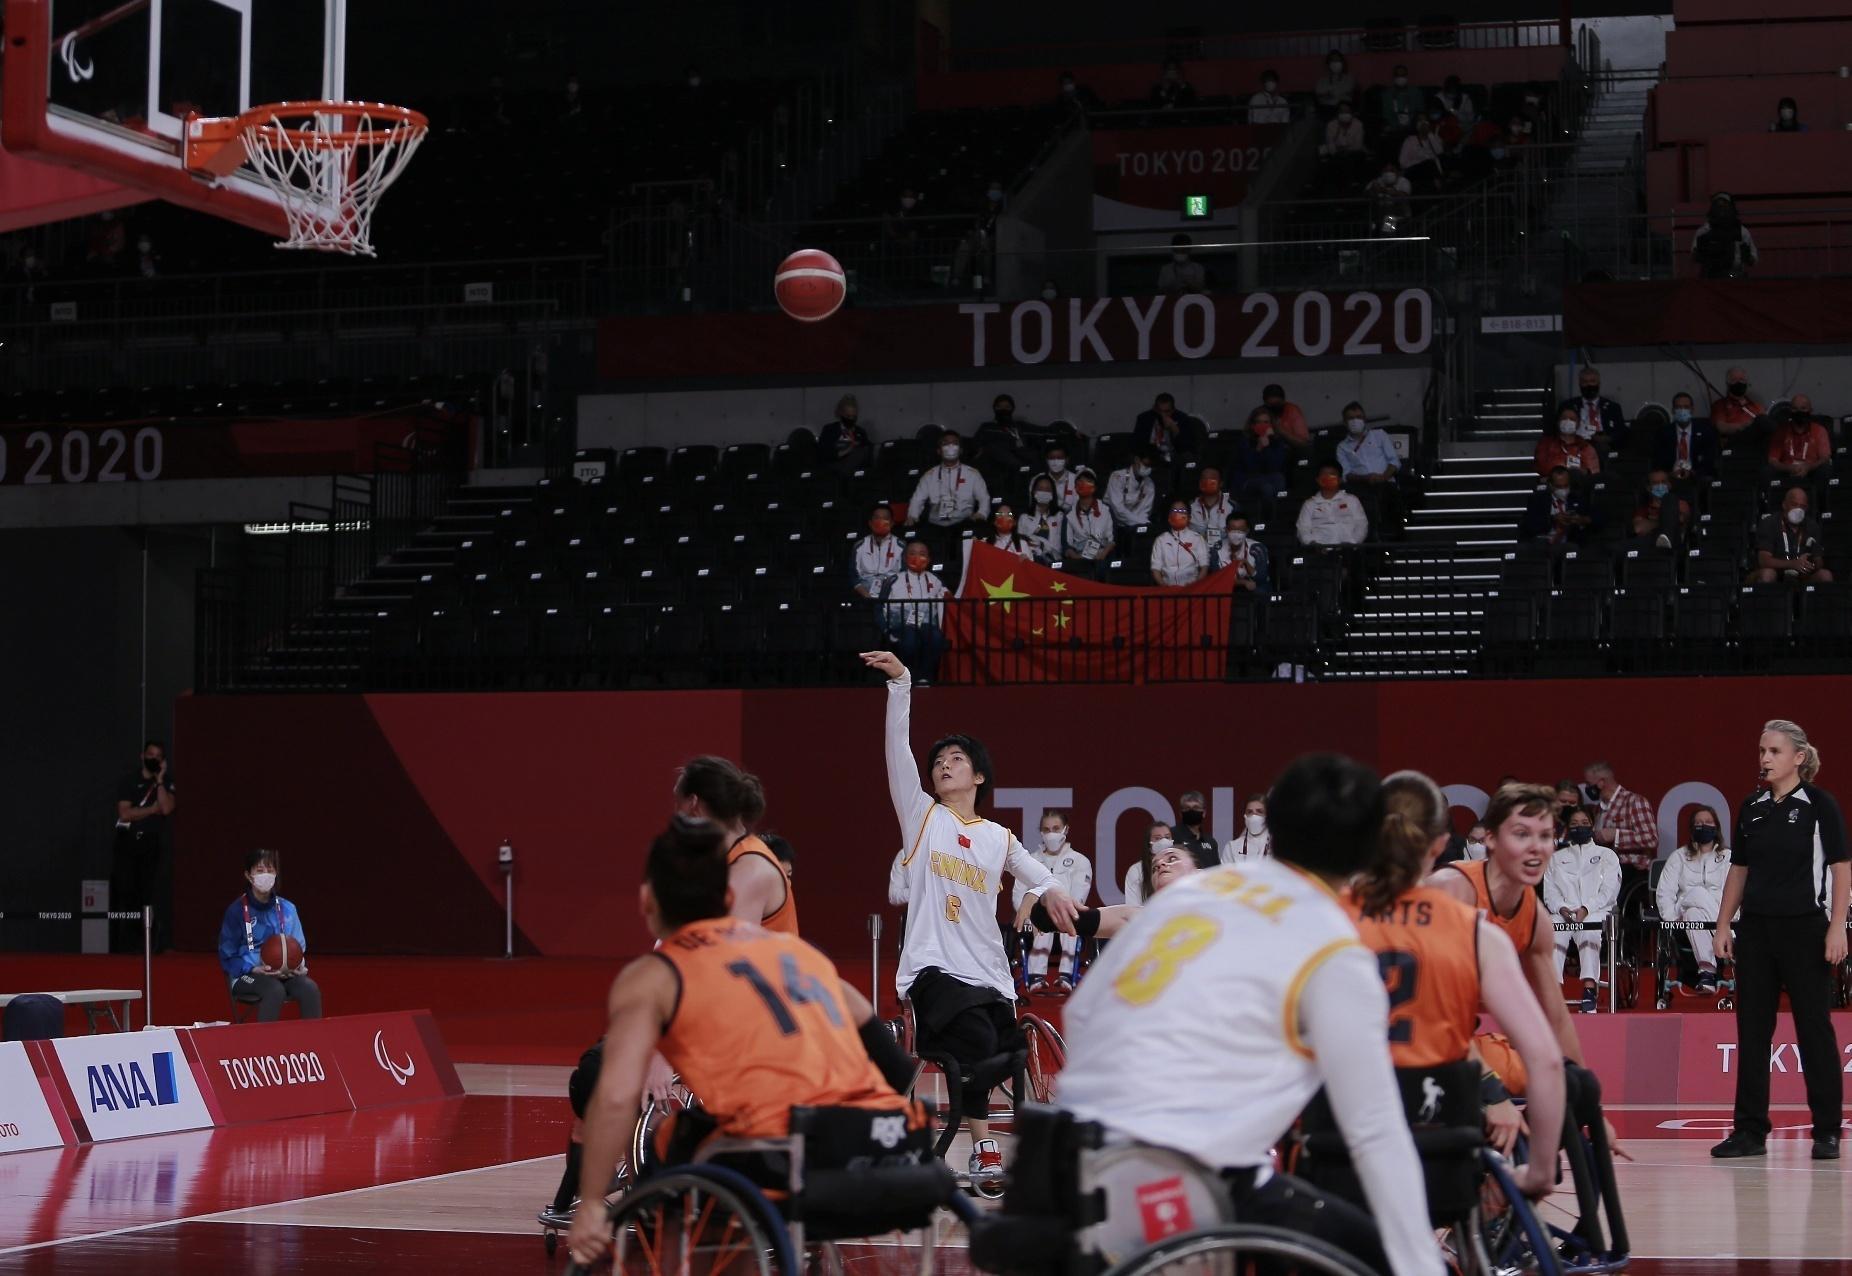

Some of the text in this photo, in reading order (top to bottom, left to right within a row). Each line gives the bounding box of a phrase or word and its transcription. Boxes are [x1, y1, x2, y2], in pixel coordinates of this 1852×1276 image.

[1116, 147, 1272, 176] TOKYO 202
[959, 288, 1432, 367] TOKYO 2020
[24, 426, 163, 484] 2020
[38, 911, 72, 920] TOKYO 2020
[107, 911, 141, 920] TOKYO 2020
[946, 894, 961, 924] 6
[1359, 900, 1433, 926] RTS
[1566, 922, 1584, 931] 2020
[1660, 921, 1704, 930] TOKYO 2020
[1113, 914, 1224, 1007] 8
[726, 953, 846, 1036] 14
[219, 1051, 326, 1090] TOKYO 2020
[87, 1061, 157, 1113] ANA
